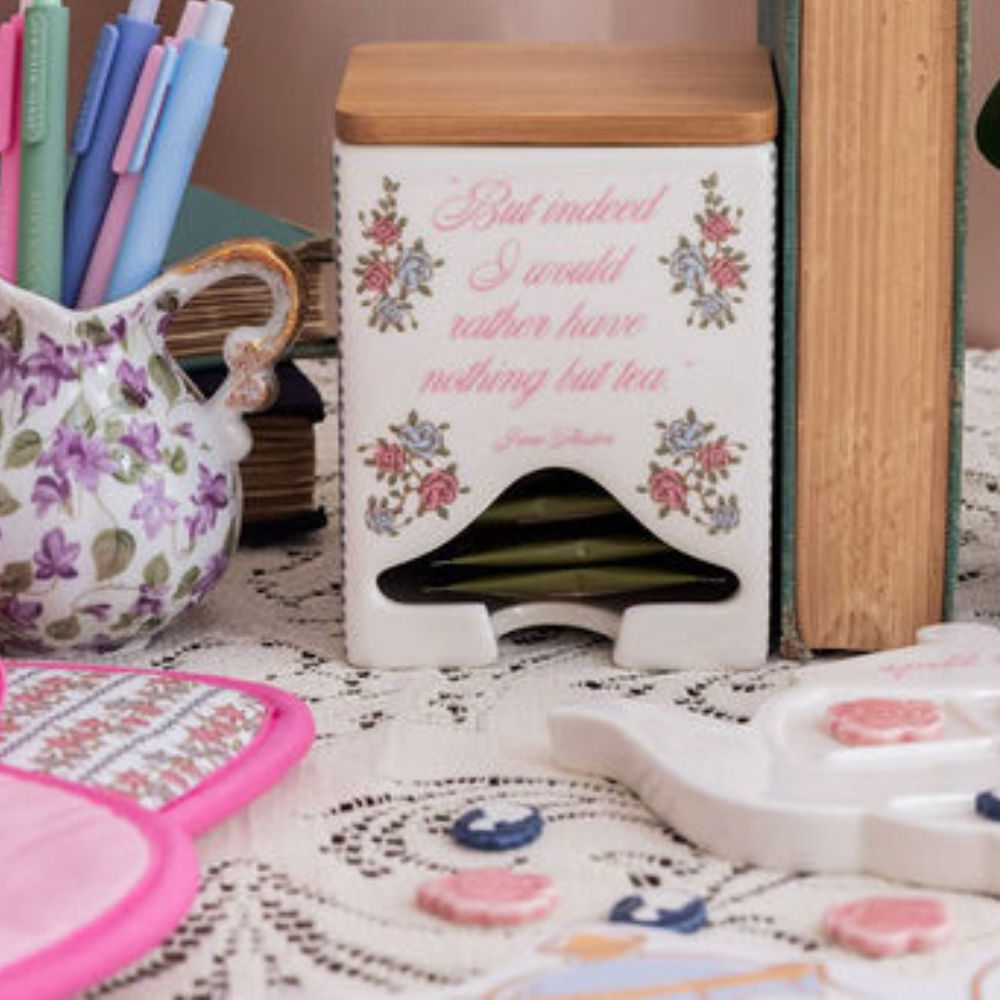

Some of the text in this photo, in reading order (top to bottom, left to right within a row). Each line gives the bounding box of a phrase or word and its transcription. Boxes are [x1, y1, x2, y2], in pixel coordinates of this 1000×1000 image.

[541, 183, 669, 224] indeed
[469, 239, 637, 292] I would
[450, 301, 646, 340] rather have
[420, 356, 550, 410] nothing
[553, 358, 614, 393] but
